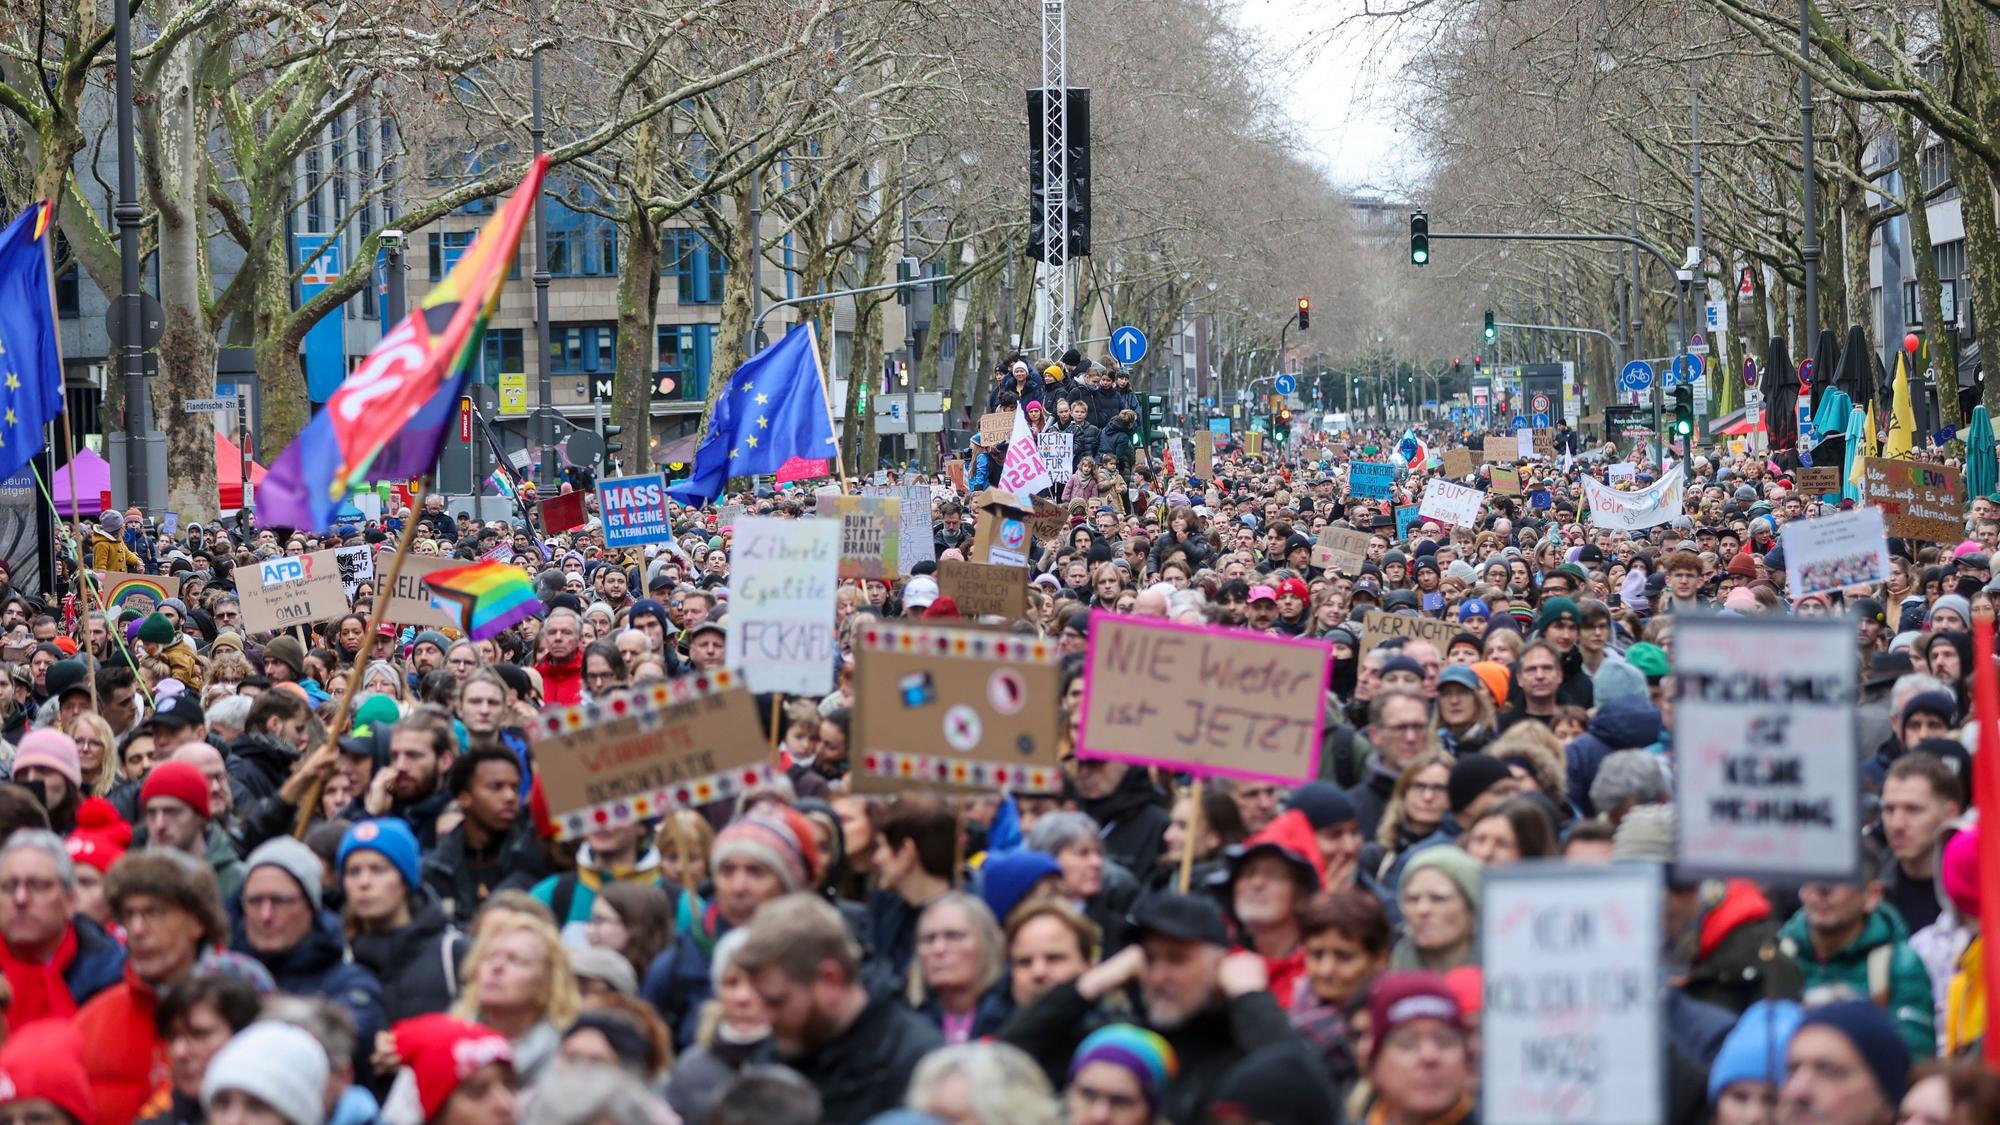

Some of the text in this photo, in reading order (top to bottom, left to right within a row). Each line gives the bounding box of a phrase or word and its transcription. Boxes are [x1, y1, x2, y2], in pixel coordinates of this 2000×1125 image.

[186, 401, 237, 411] Flandrische Str.
[1536, 400, 1545, 408] 30
[1040, 434, 1066, 445] KEIN
[1048, 471, 1070, 484] AZIS
[604, 484, 661, 510] HASS
[608, 509, 664, 527] IST KEINE
[845, 515, 874, 527] BUNT
[610, 524, 667, 539] ALTERNATIVE
[844, 529, 881, 541] STATT
[843, 541, 880, 554] BRAUN
[946, 566, 1019, 582] NAZIS ESSEN
[958, 583, 1008, 596] HEIMLICH
[275, 601, 312, 620] OMA!
[1366, 613, 1403, 635] WER
[1106, 628, 1185, 683] NIE
[1105, 699, 1316, 756] ist JETZT
